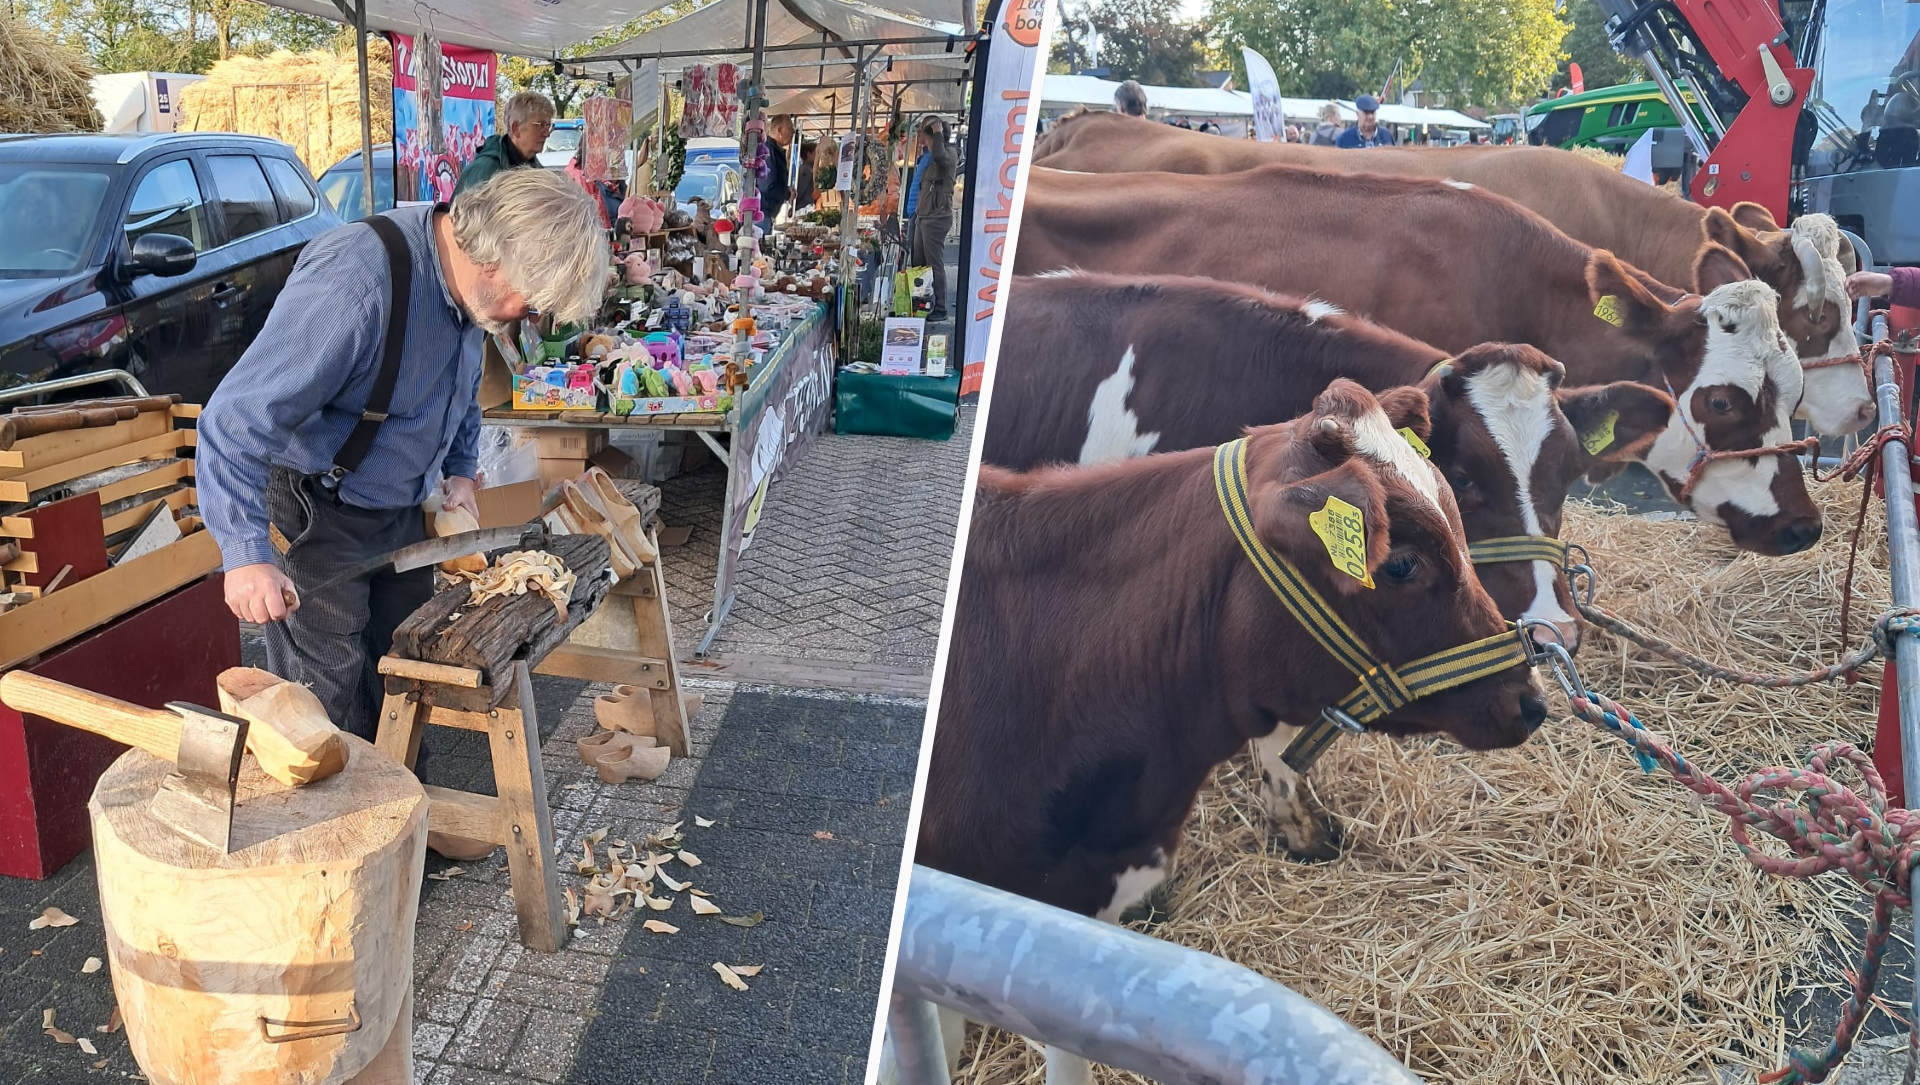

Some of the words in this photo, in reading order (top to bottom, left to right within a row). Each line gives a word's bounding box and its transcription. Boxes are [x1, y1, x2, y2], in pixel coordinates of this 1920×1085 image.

[158, 93, 168, 103] 25
[1331, 542, 1338, 556] NL
[1343, 516, 1365, 578] 0258
